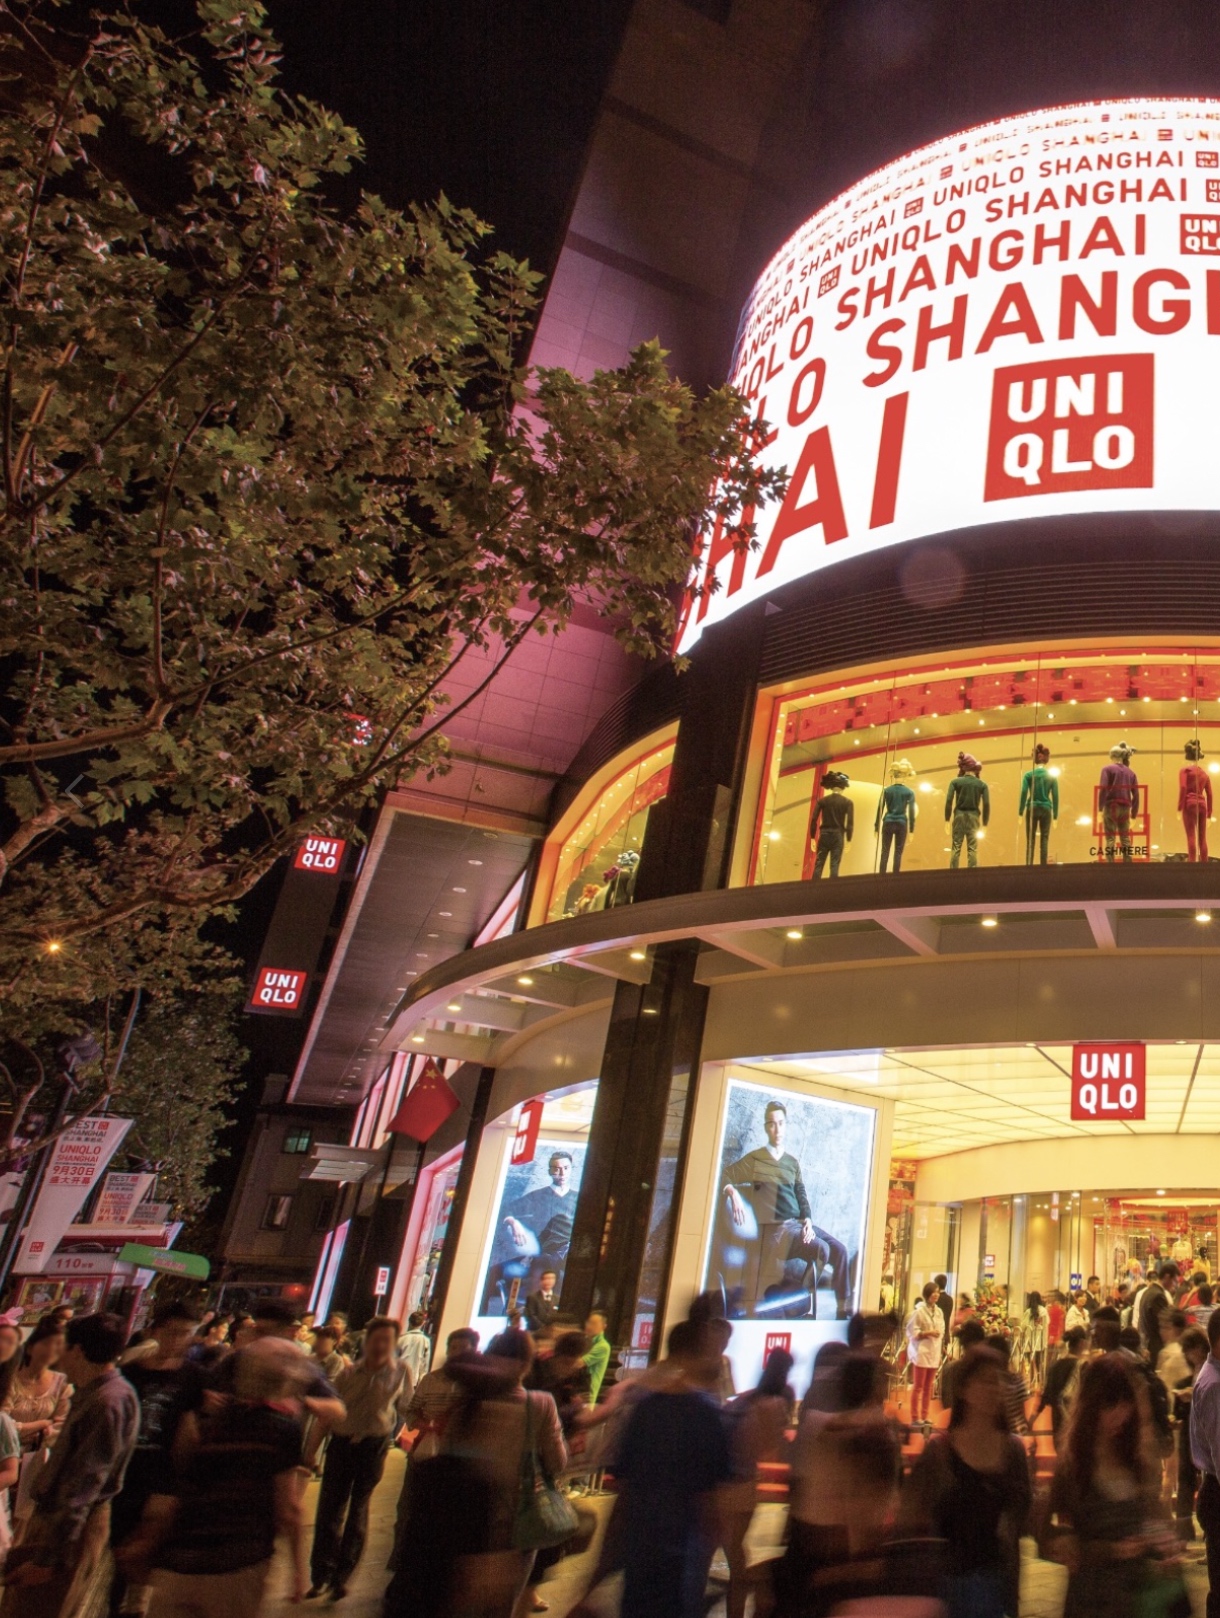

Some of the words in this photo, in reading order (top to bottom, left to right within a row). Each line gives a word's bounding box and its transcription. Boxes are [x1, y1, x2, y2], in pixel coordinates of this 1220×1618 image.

[933, 166, 1024, 206] UNIQLO
[1039, 151, 1183, 178] SHANGHAI
[851, 209, 966, 275] UNIQLO
[985, 178, 1187, 223] SHANGHAI
[800, 210, 895, 282] SHANGHAI
[835, 214, 1146, 331] SHANGHAI
[1007, 371, 1124, 423] UNI
[1003, 424, 1135, 486] QLO
[305, 839, 338, 854] UNI
[1089, 846, 1149, 857] CASHMERE
[302, 852, 337, 869] QLO
[264, 972, 298, 989] UNI
[259, 987, 297, 1004] QLO
[1079, 1053, 1133, 1080] UNI
[1078, 1083, 1138, 1114] QLO
[73, 1120, 98, 1130] EST
[60, 1144, 102, 1155] UNIQLO
[57, 1155, 99, 1163] SHANGHAI
[53, 1165, 95, 1176] 9月30日
[56, 1258, 81, 1269] 110
[767, 1336, 787, 1349] UNI
